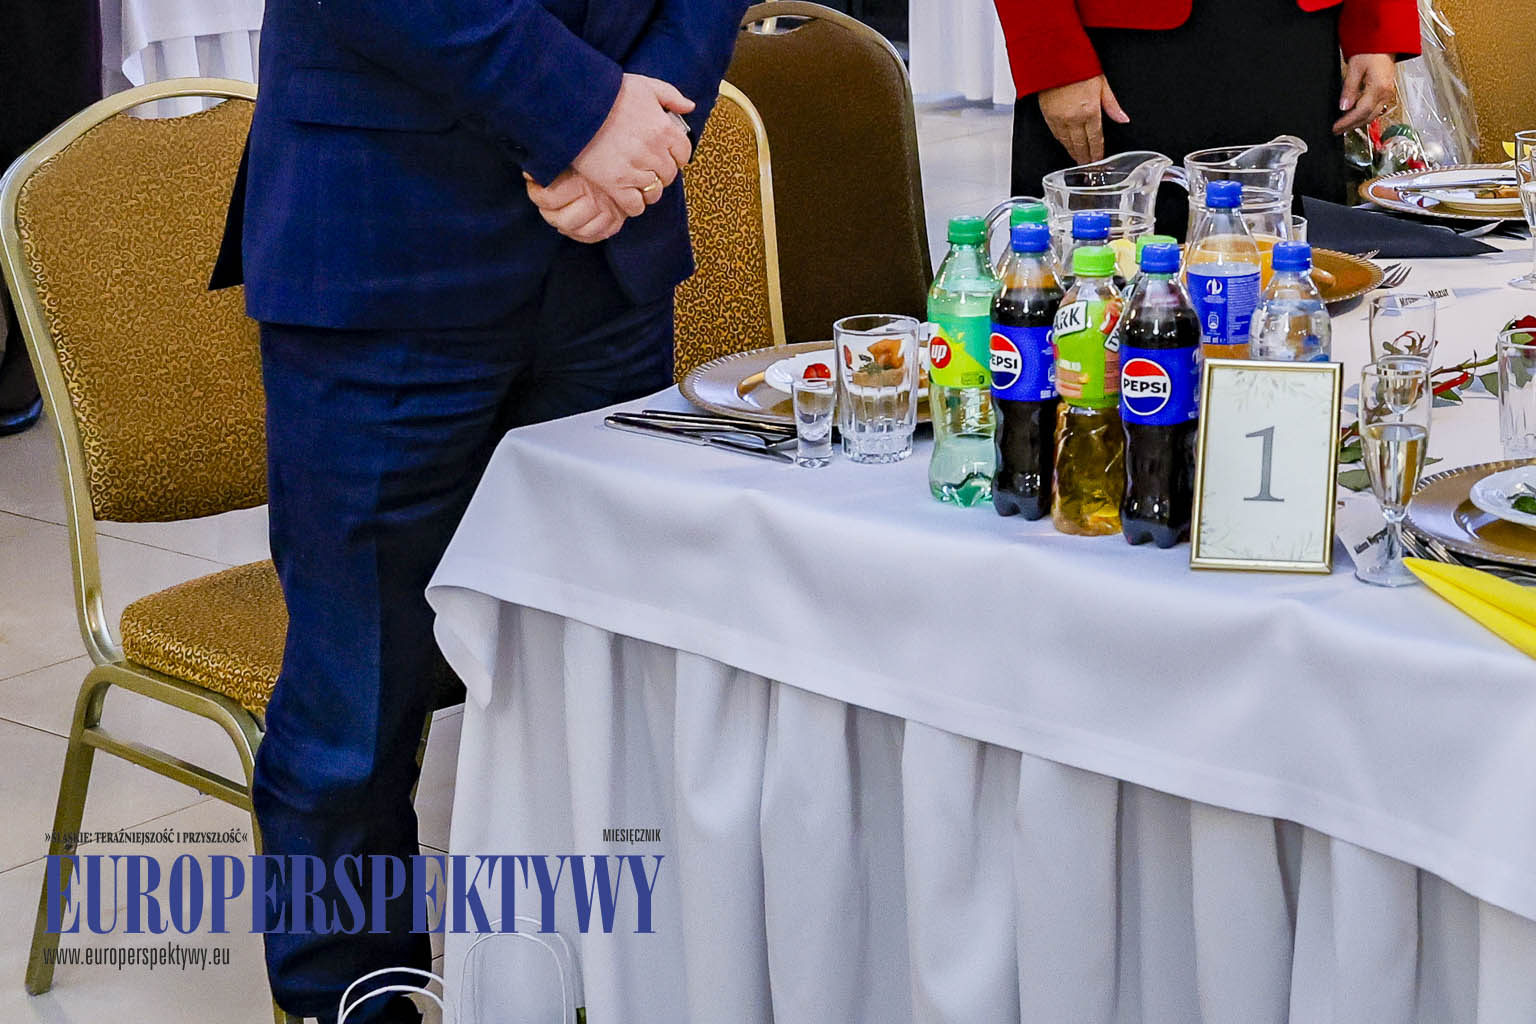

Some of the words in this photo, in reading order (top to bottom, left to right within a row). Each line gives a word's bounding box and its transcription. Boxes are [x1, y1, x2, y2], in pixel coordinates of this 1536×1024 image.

[991, 354, 1018, 369] EPSI
[1123, 378, 1167, 394] PEPSI
[1243, 425, 1285, 502] 1
